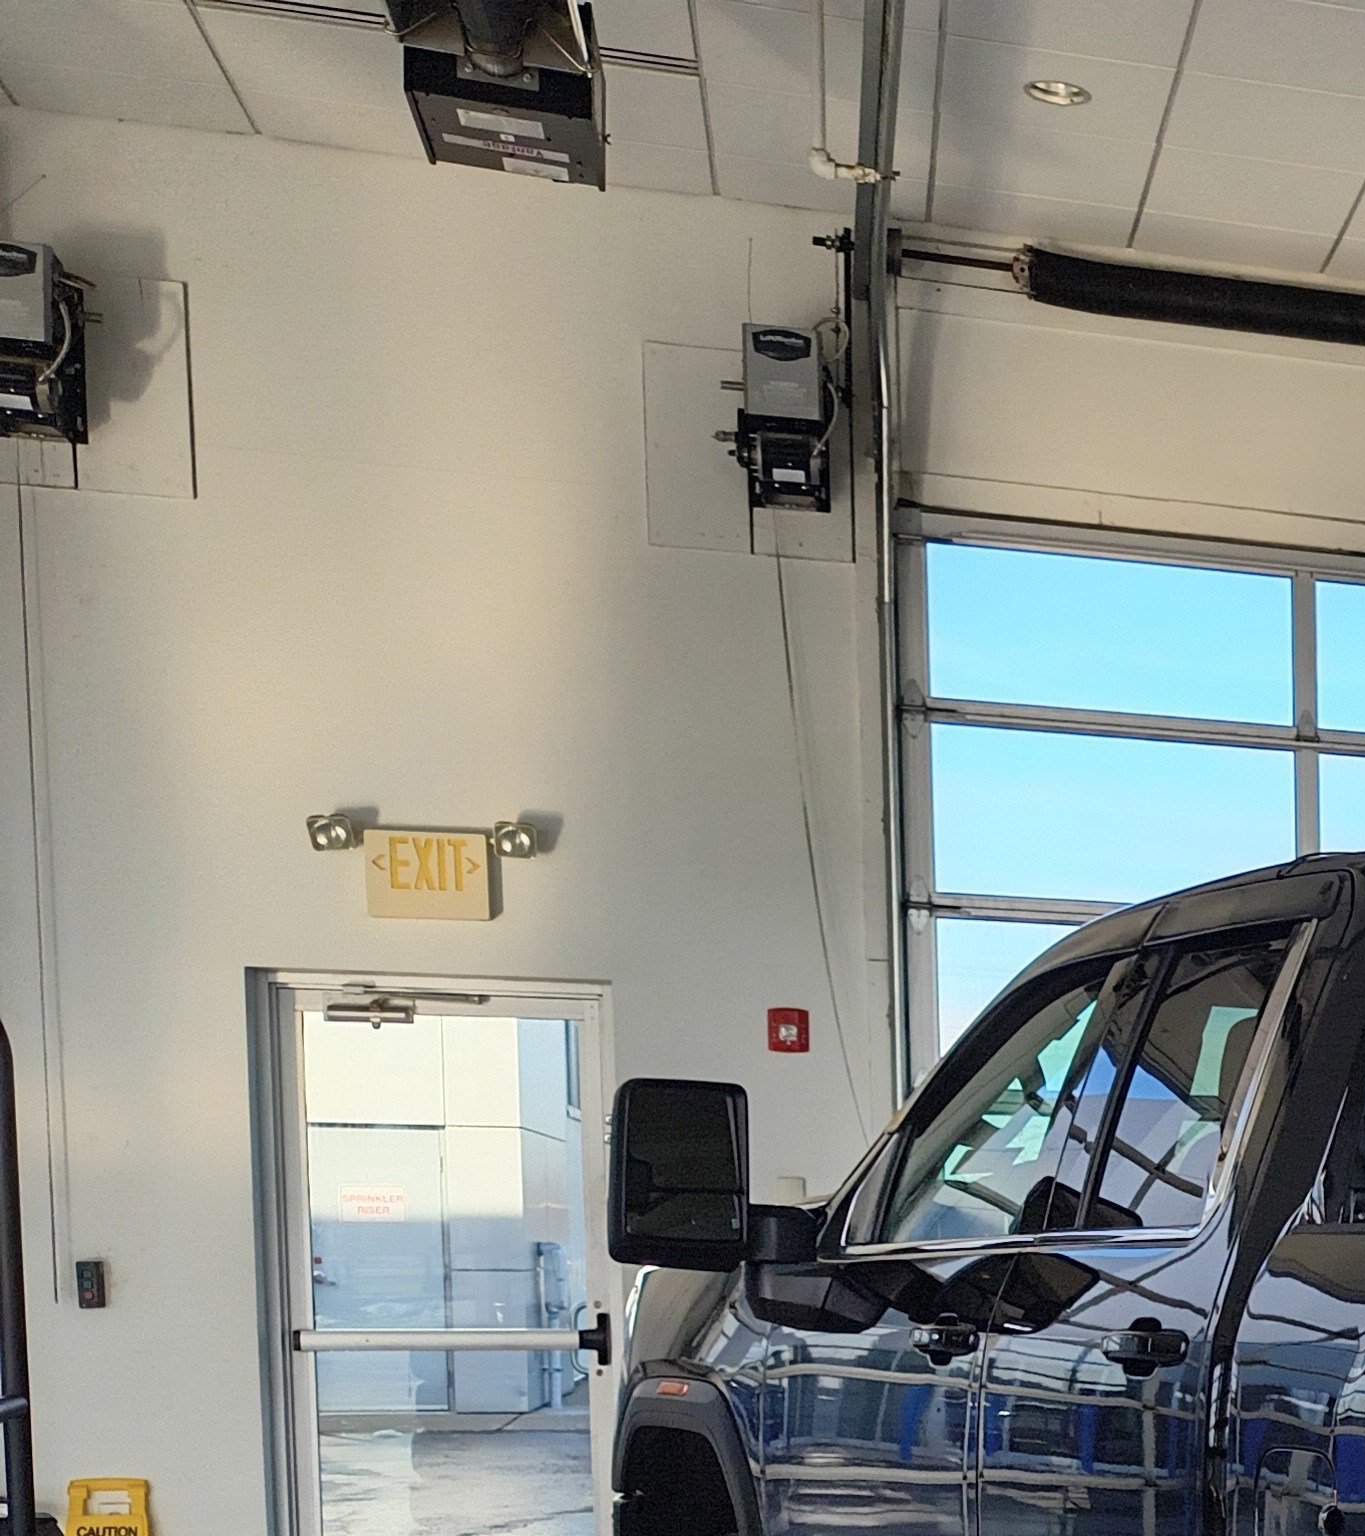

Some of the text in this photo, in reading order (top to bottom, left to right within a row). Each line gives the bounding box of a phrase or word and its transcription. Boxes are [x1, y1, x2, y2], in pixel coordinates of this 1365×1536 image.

[388, 836, 468, 892] EXIT
[341, 1194, 404, 1204] SPRINKLER
[357, 1206, 390, 1214] RISER
